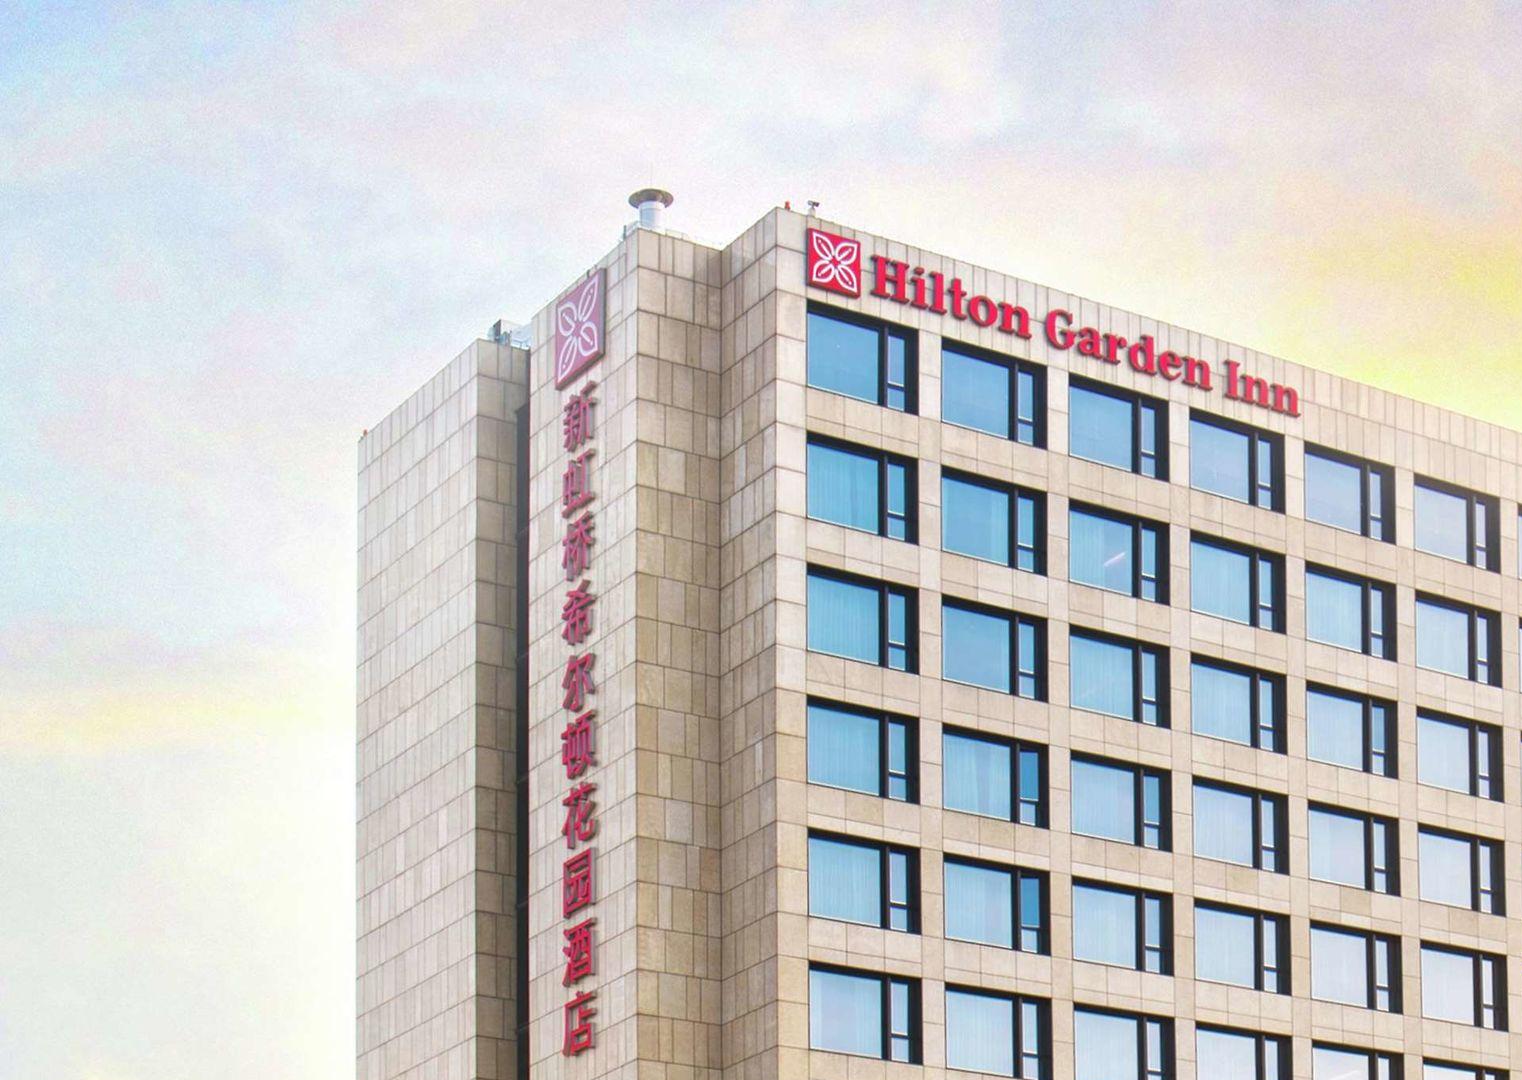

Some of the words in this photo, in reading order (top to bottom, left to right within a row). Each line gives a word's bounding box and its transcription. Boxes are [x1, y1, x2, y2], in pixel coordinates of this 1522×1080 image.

[870, 254, 1032, 341] Hilton
[1044, 309, 1213, 392] Garden
[1223, 359, 1301, 418] Inn
[561, 380, 598, 1057] 新虹桥希尔顿花园酒店
